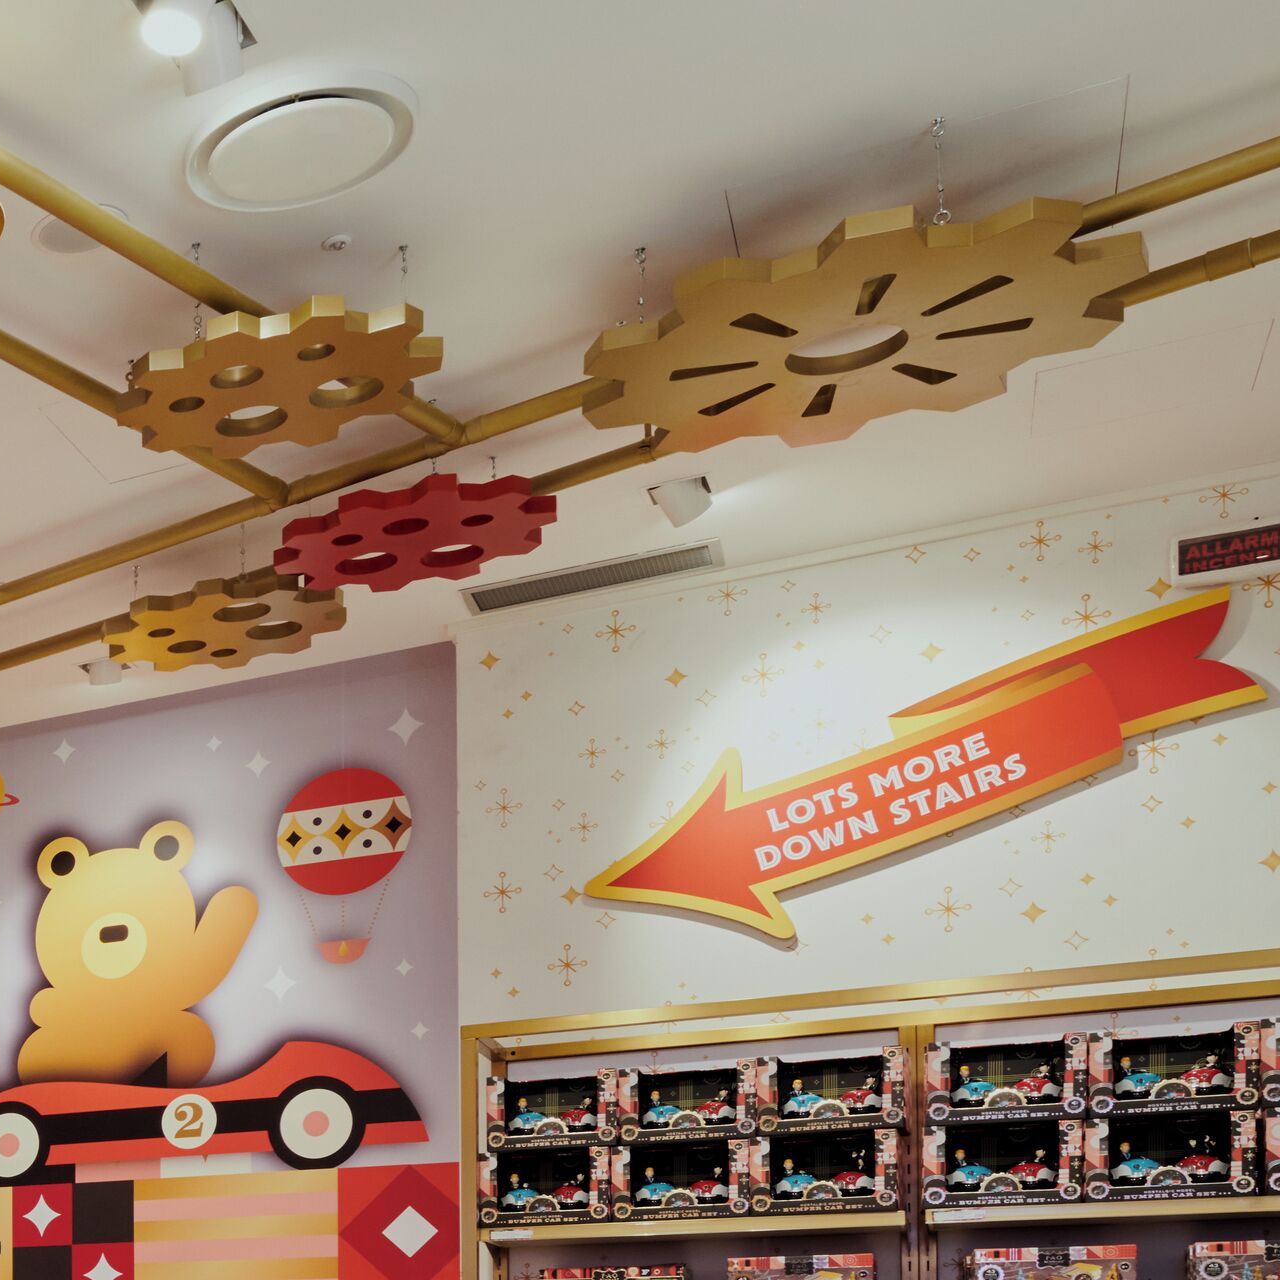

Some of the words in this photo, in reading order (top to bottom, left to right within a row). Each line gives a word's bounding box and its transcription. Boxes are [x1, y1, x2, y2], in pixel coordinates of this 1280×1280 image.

[753, 810, 879, 871] DOWN
[889, 753, 1027, 825] STAIRS
[766, 782, 858, 833] LOTS
[867, 731, 991, 797] MORE
[175, 1102, 204, 1139] 2
